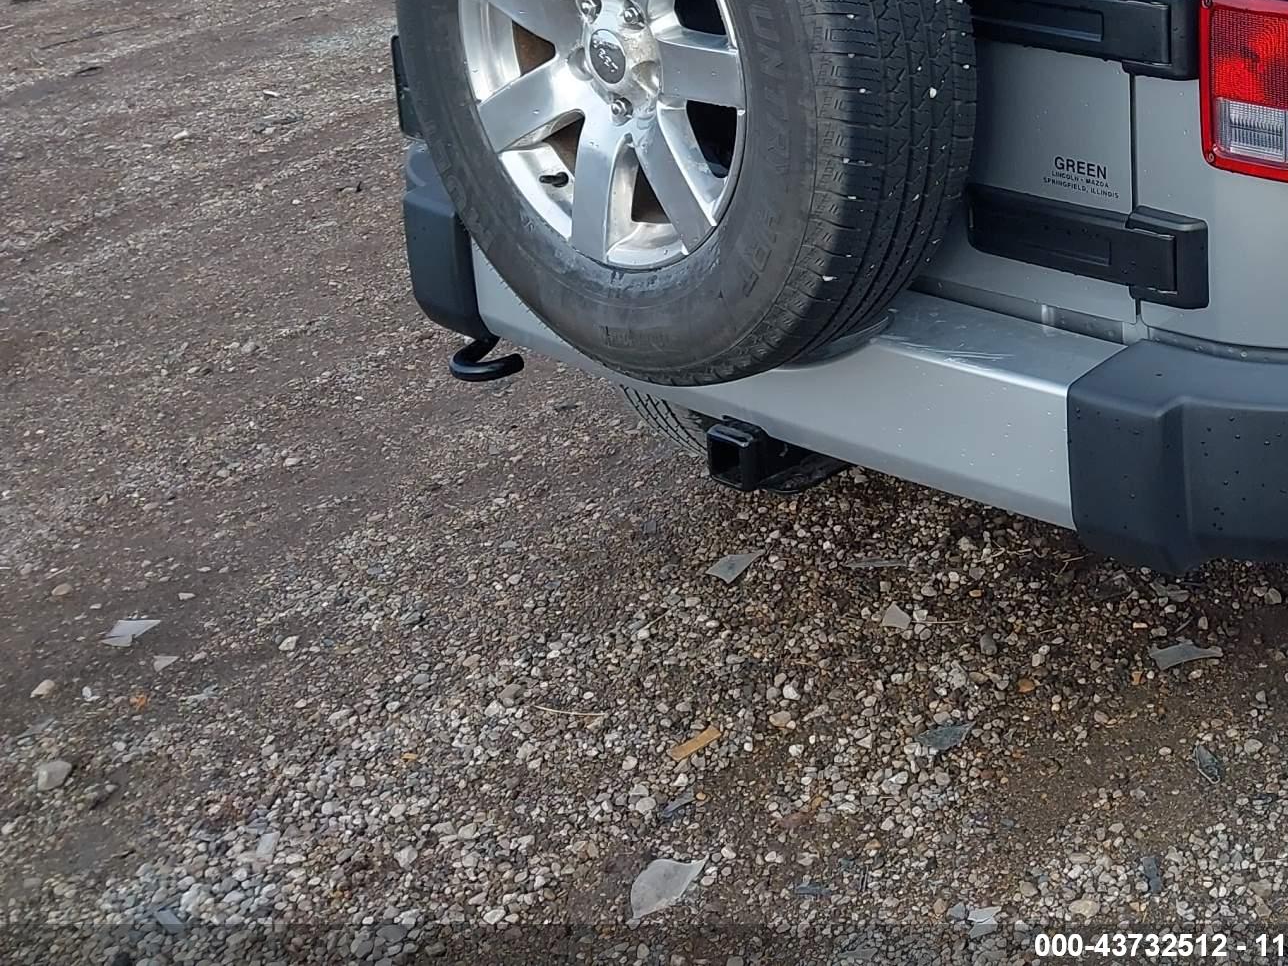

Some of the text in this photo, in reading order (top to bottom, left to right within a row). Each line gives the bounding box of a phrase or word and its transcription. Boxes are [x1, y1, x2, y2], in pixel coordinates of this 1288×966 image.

[1051, 170, 1079, 182] LINCOLN
[1053, 155, 1107, 180] GREEN
[1043, 177, 1119, 199] SPRINGFIELD, ILLINOIS
